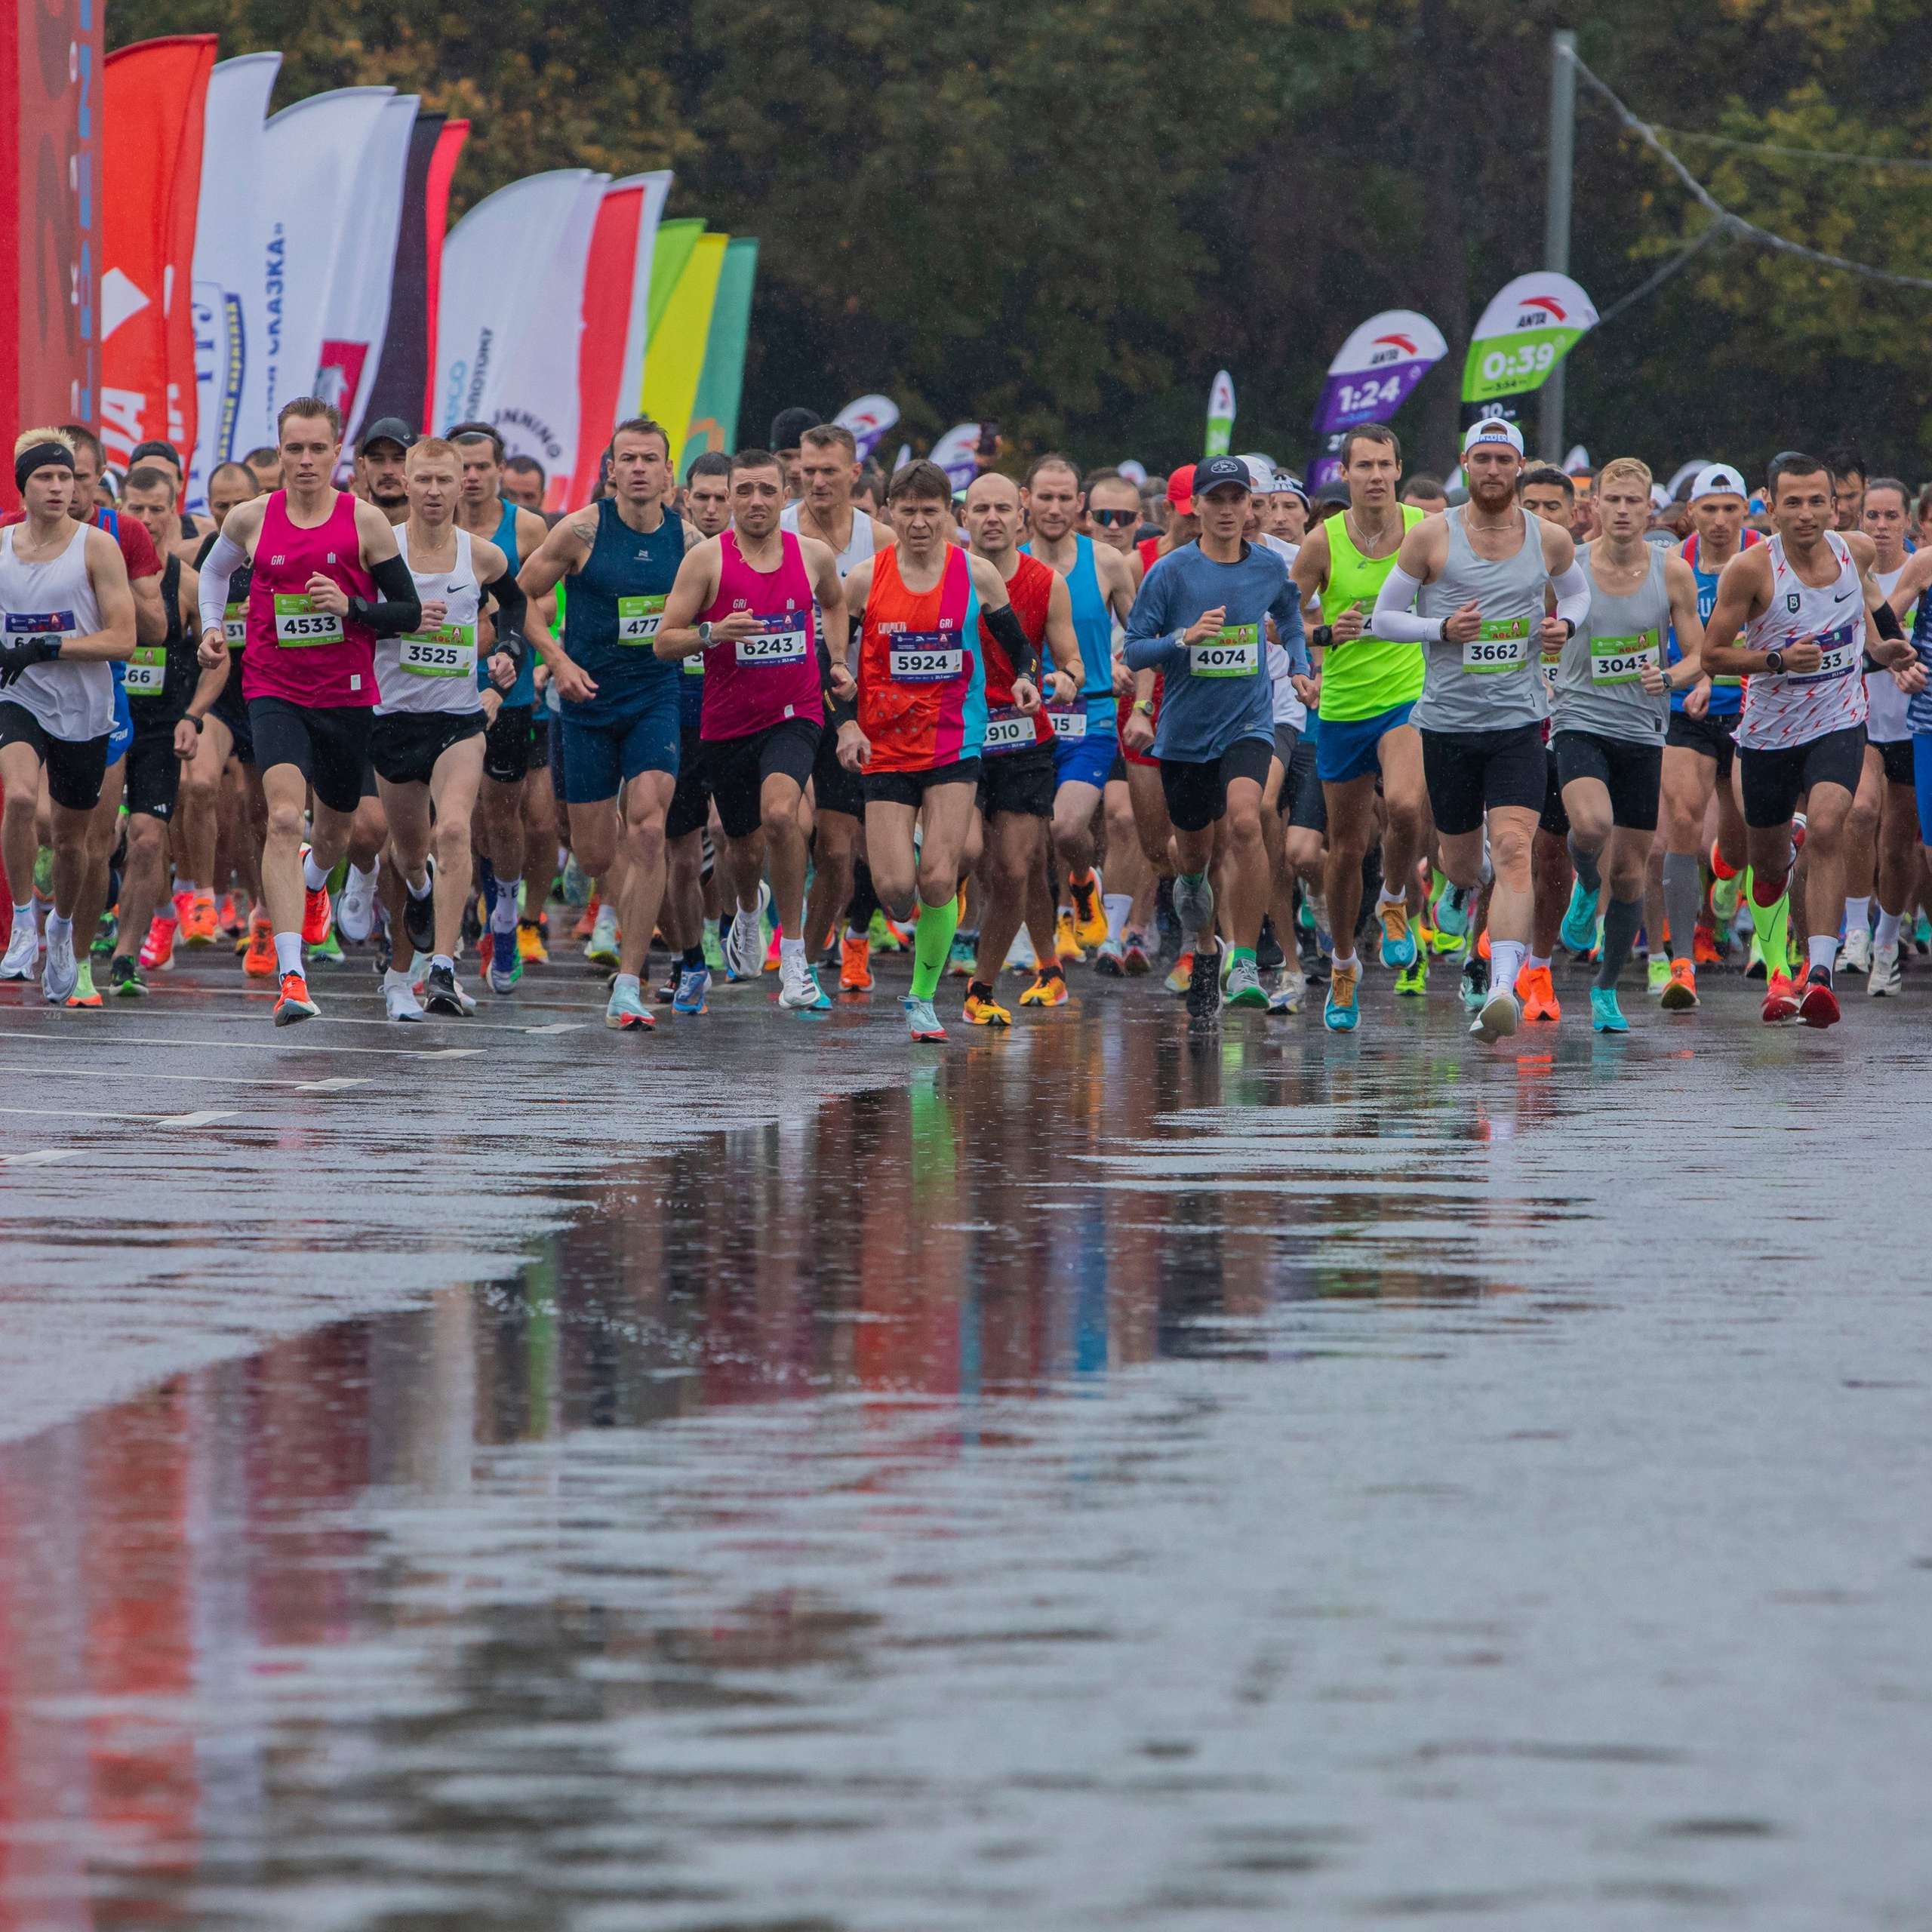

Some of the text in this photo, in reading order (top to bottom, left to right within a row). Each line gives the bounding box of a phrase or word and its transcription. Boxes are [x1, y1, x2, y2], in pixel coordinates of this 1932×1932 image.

[1483, 343, 1555, 380] 0:39
[1338, 375, 1401, 414] 1:24
[1480, 402, 1504, 420] 10
[284, 616, 337, 634] 4533
[627, 617, 663, 634] 477
[408, 645, 457, 664] 3525
[743, 637, 793, 655] 6243
[1471, 644, 1518, 660] 3662
[898, 655, 948, 670] 5924
[1197, 649, 1246, 665] 4074
[1598, 654, 1647, 673] 3043
[1821, 652, 1841, 669] 33
